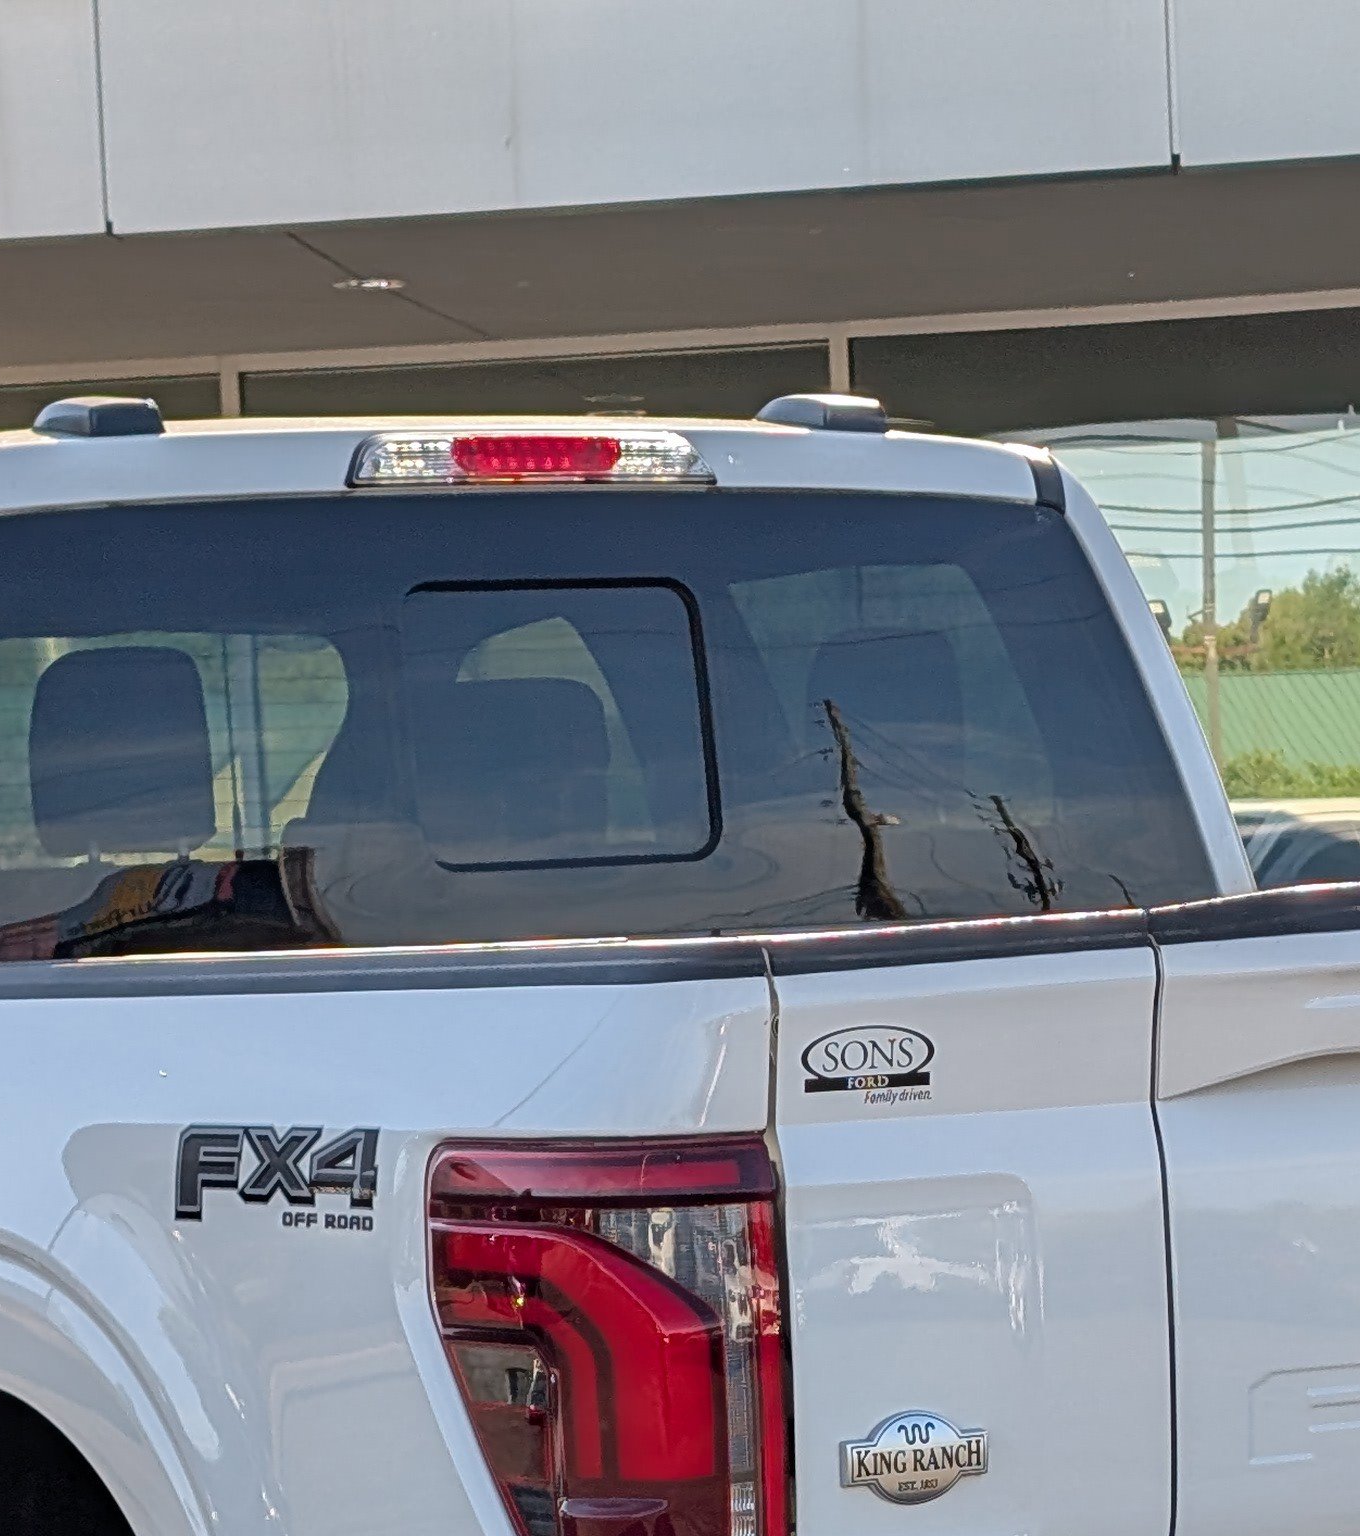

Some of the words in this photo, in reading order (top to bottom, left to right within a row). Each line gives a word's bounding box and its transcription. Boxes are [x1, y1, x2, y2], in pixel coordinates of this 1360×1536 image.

[822, 1037, 914, 1072] SONS
[847, 1075, 890, 1089] FORD
[864, 1089, 898, 1105] Family
[899, 1089, 932, 1101] driven
[175, 1124, 382, 1222] FX4
[282, 1211, 317, 1228] OFF
[324, 1213, 374, 1232] ROAD
[856, 1450, 907, 1478] KING
[913, 1439, 982, 1472] RANCH
